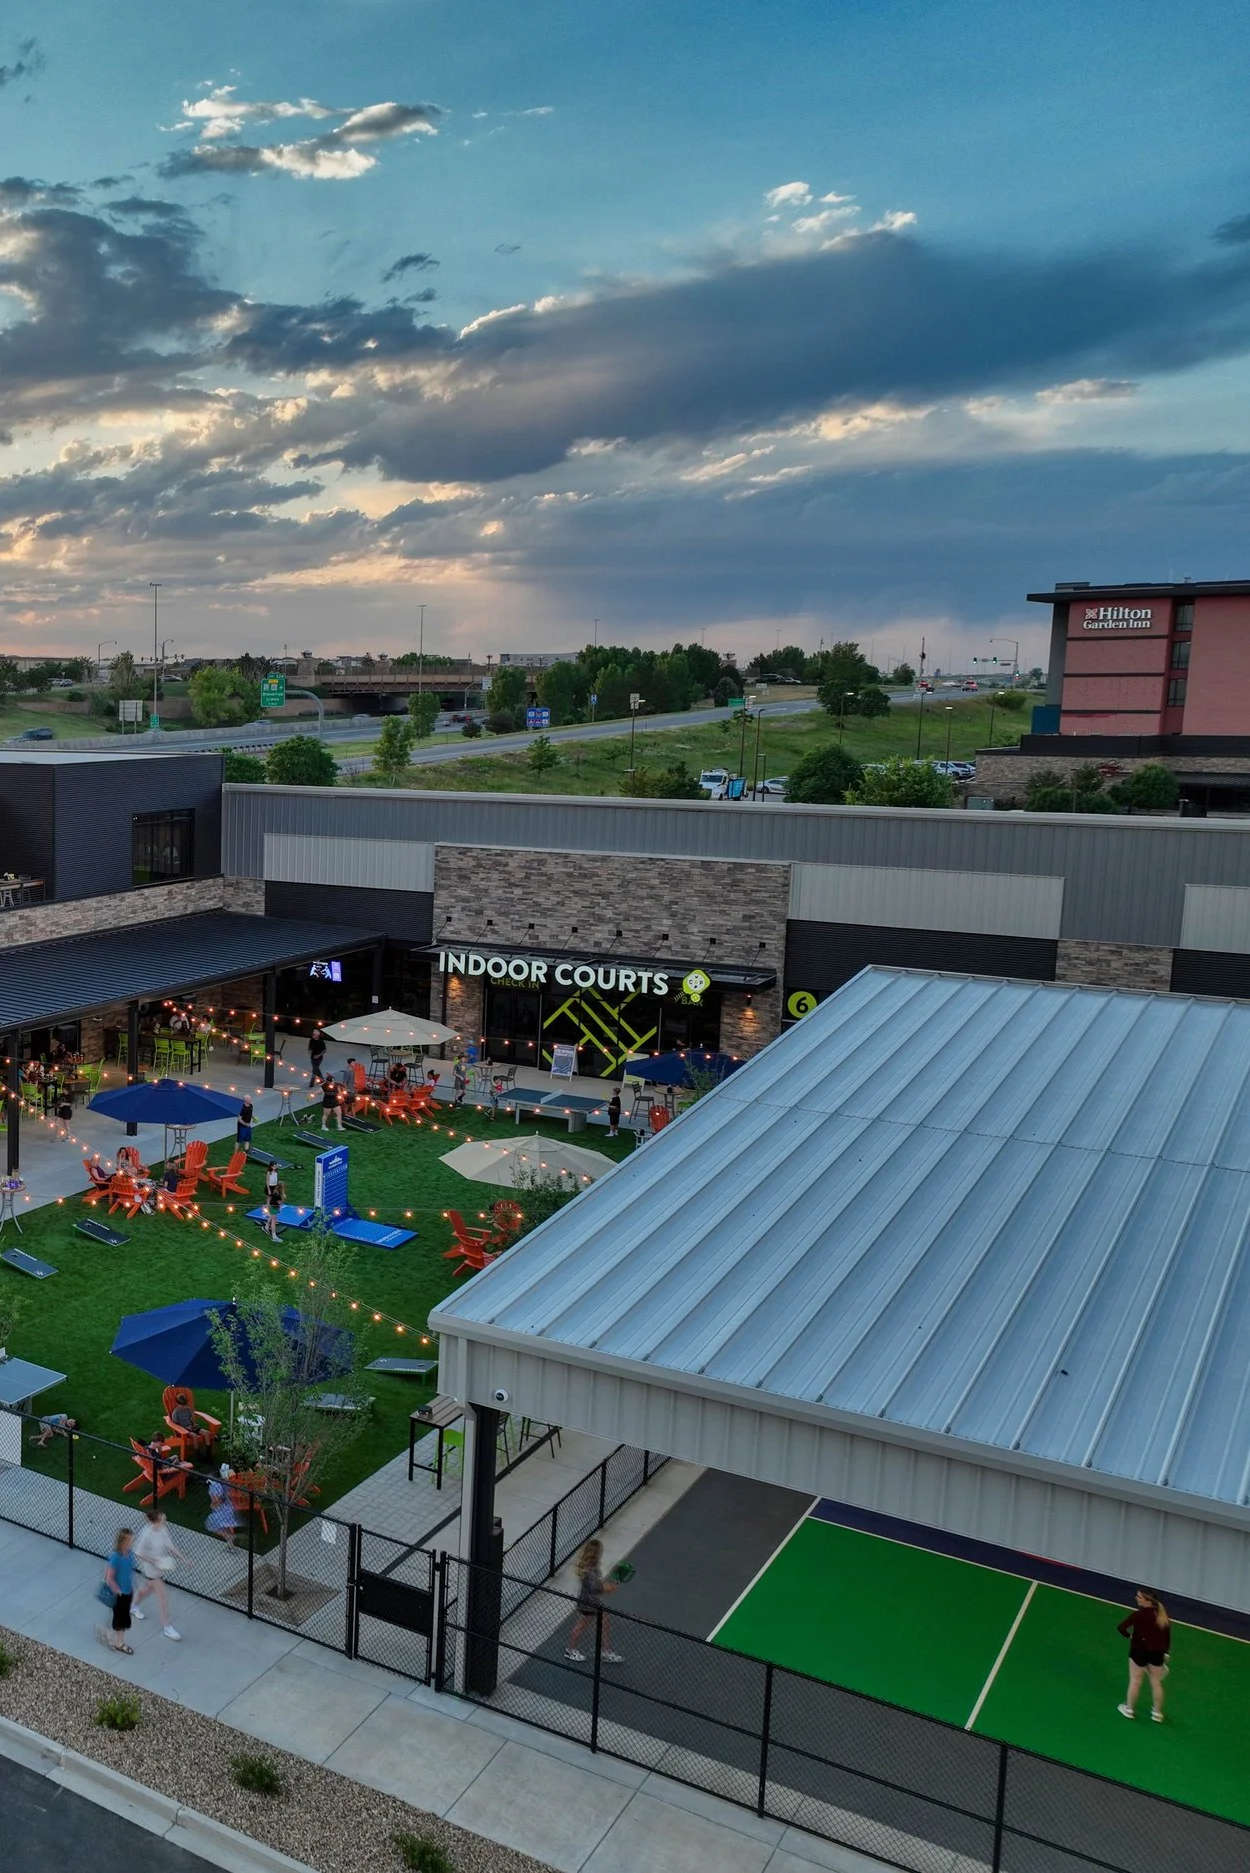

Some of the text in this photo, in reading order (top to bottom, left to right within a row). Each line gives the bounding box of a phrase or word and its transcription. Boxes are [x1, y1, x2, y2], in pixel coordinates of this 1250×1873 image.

[1098, 607, 1152, 620] Hilton
[1083, 619, 1151, 630] Garden Inn
[439, 952, 670, 996] INDOOR COURTS
[490, 977, 540, 989] CHECK IN
[795, 996, 809, 1014] 6
